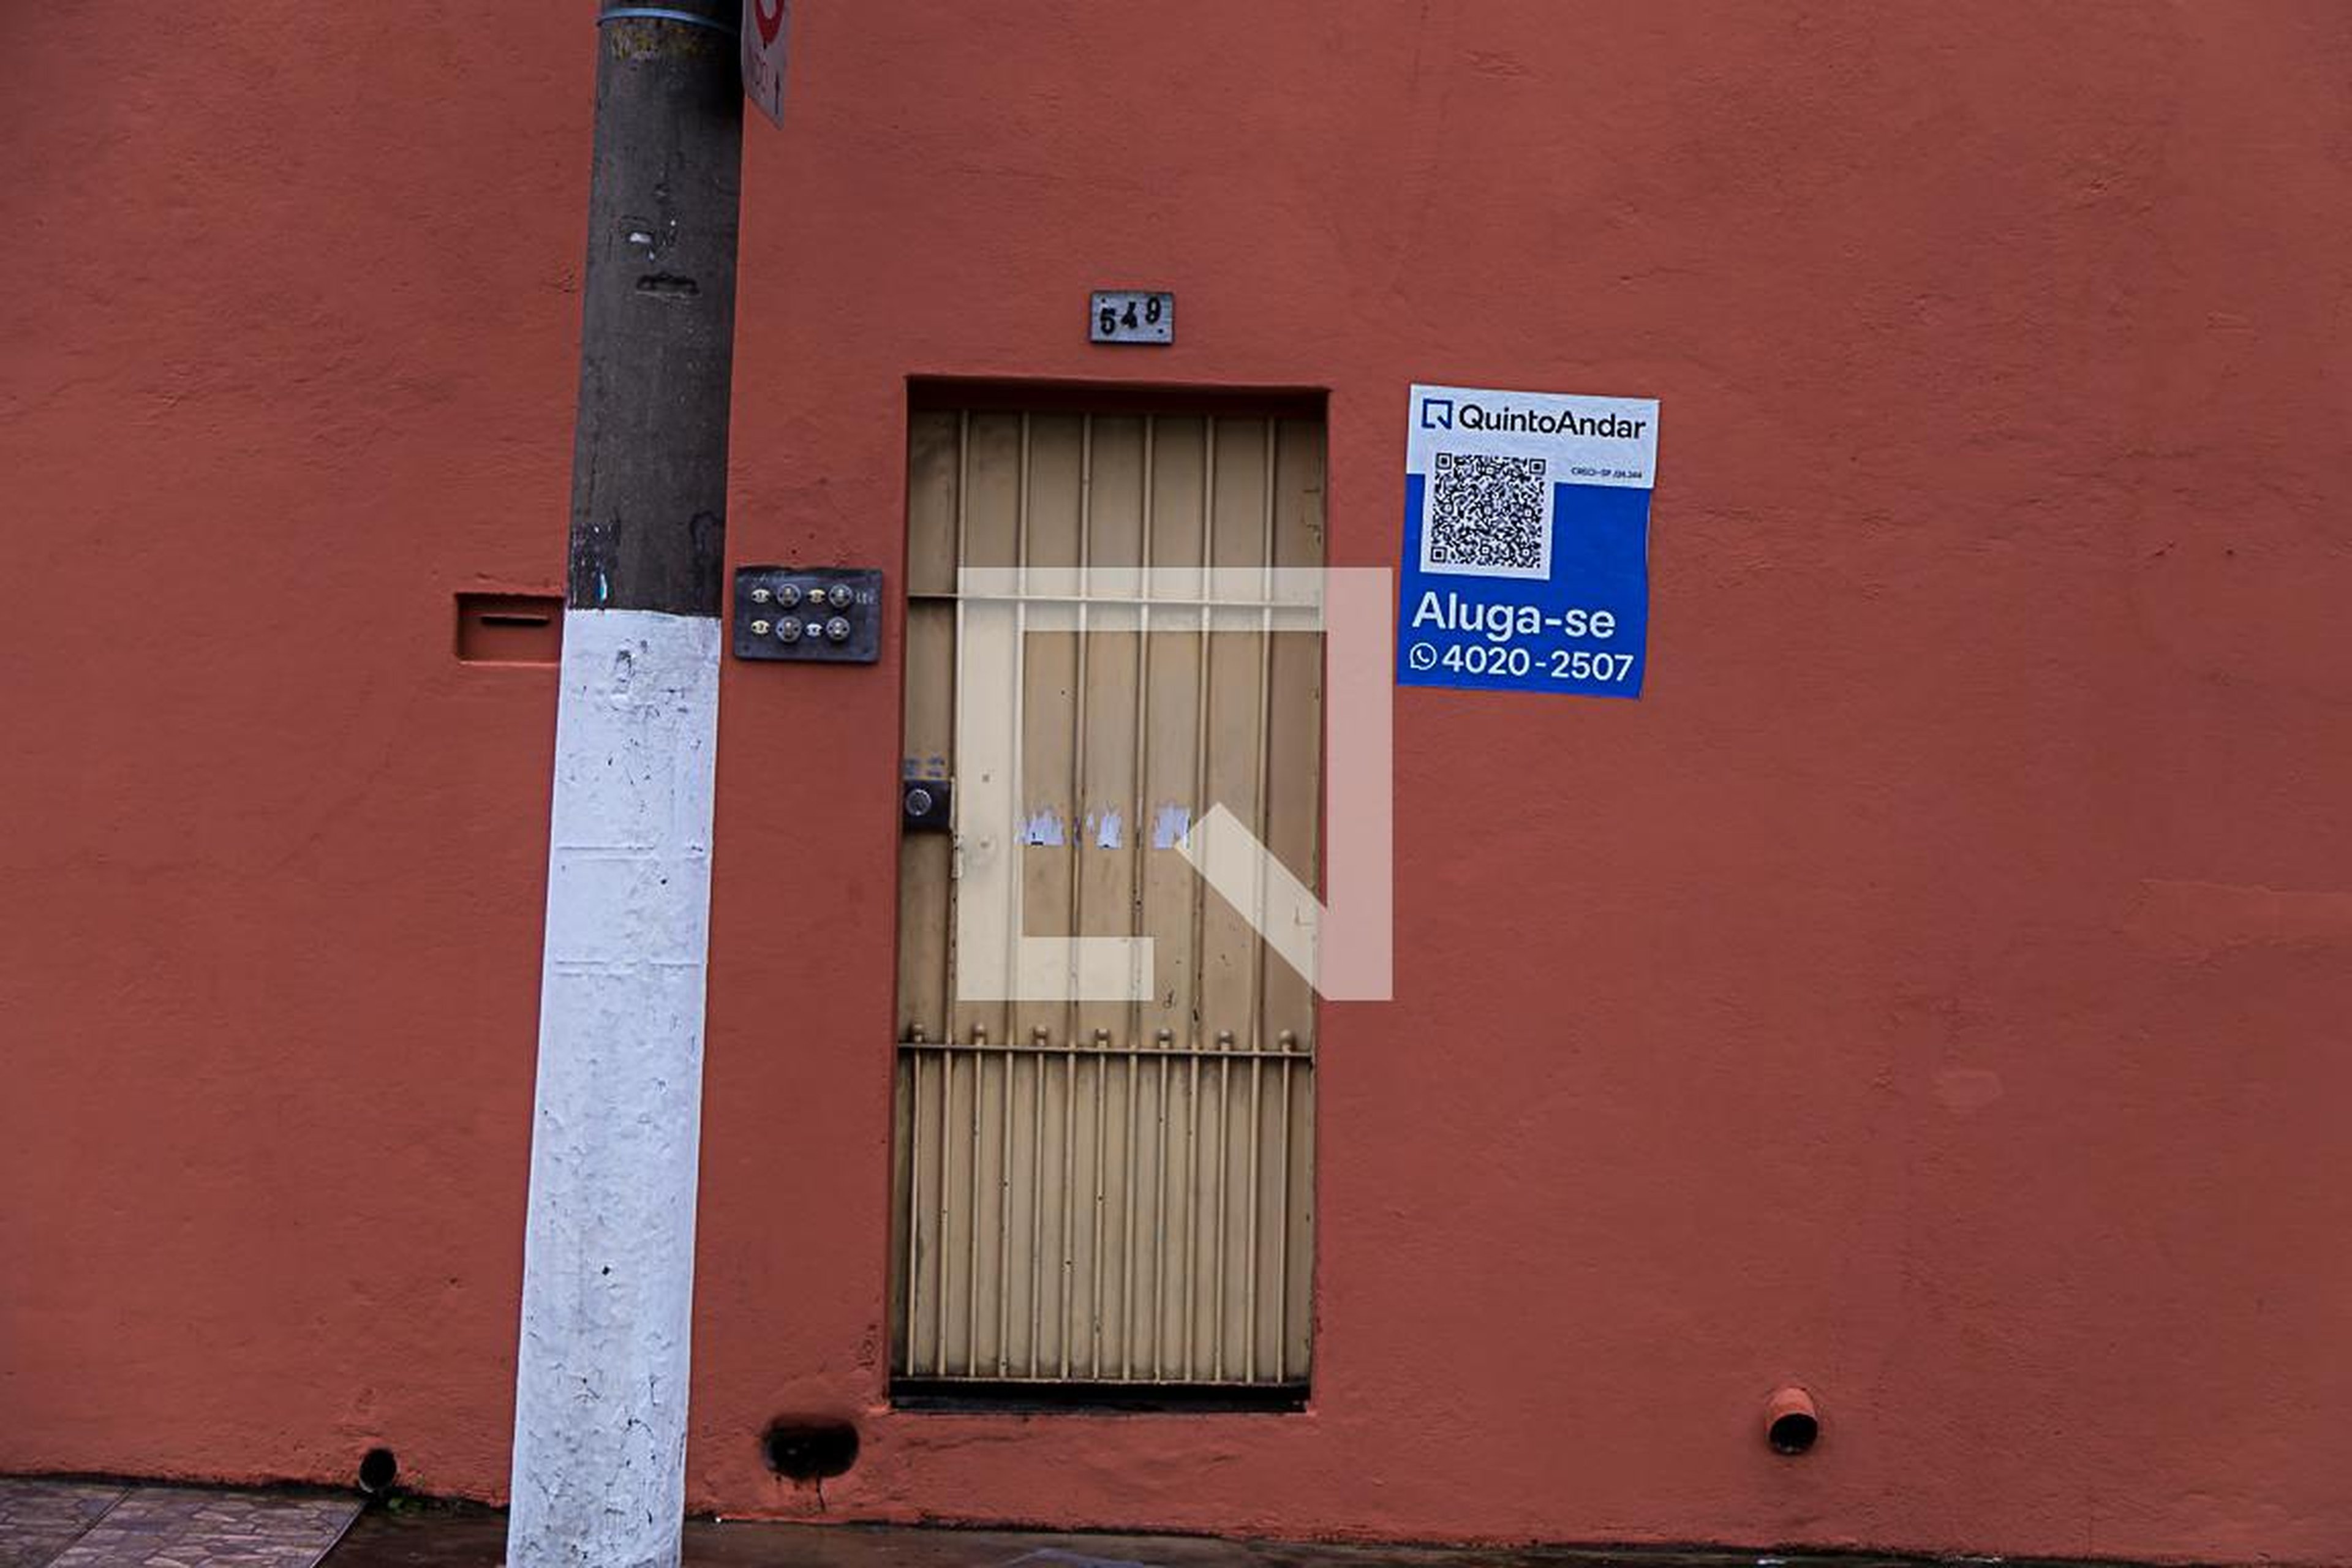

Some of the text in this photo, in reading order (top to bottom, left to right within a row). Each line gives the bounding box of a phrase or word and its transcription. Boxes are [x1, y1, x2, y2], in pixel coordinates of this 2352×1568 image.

[1100, 297, 1161, 334] 549
[1459, 404, 1646, 439] QuintoAndar
[1412, 591, 1615, 642] Aluga-se
